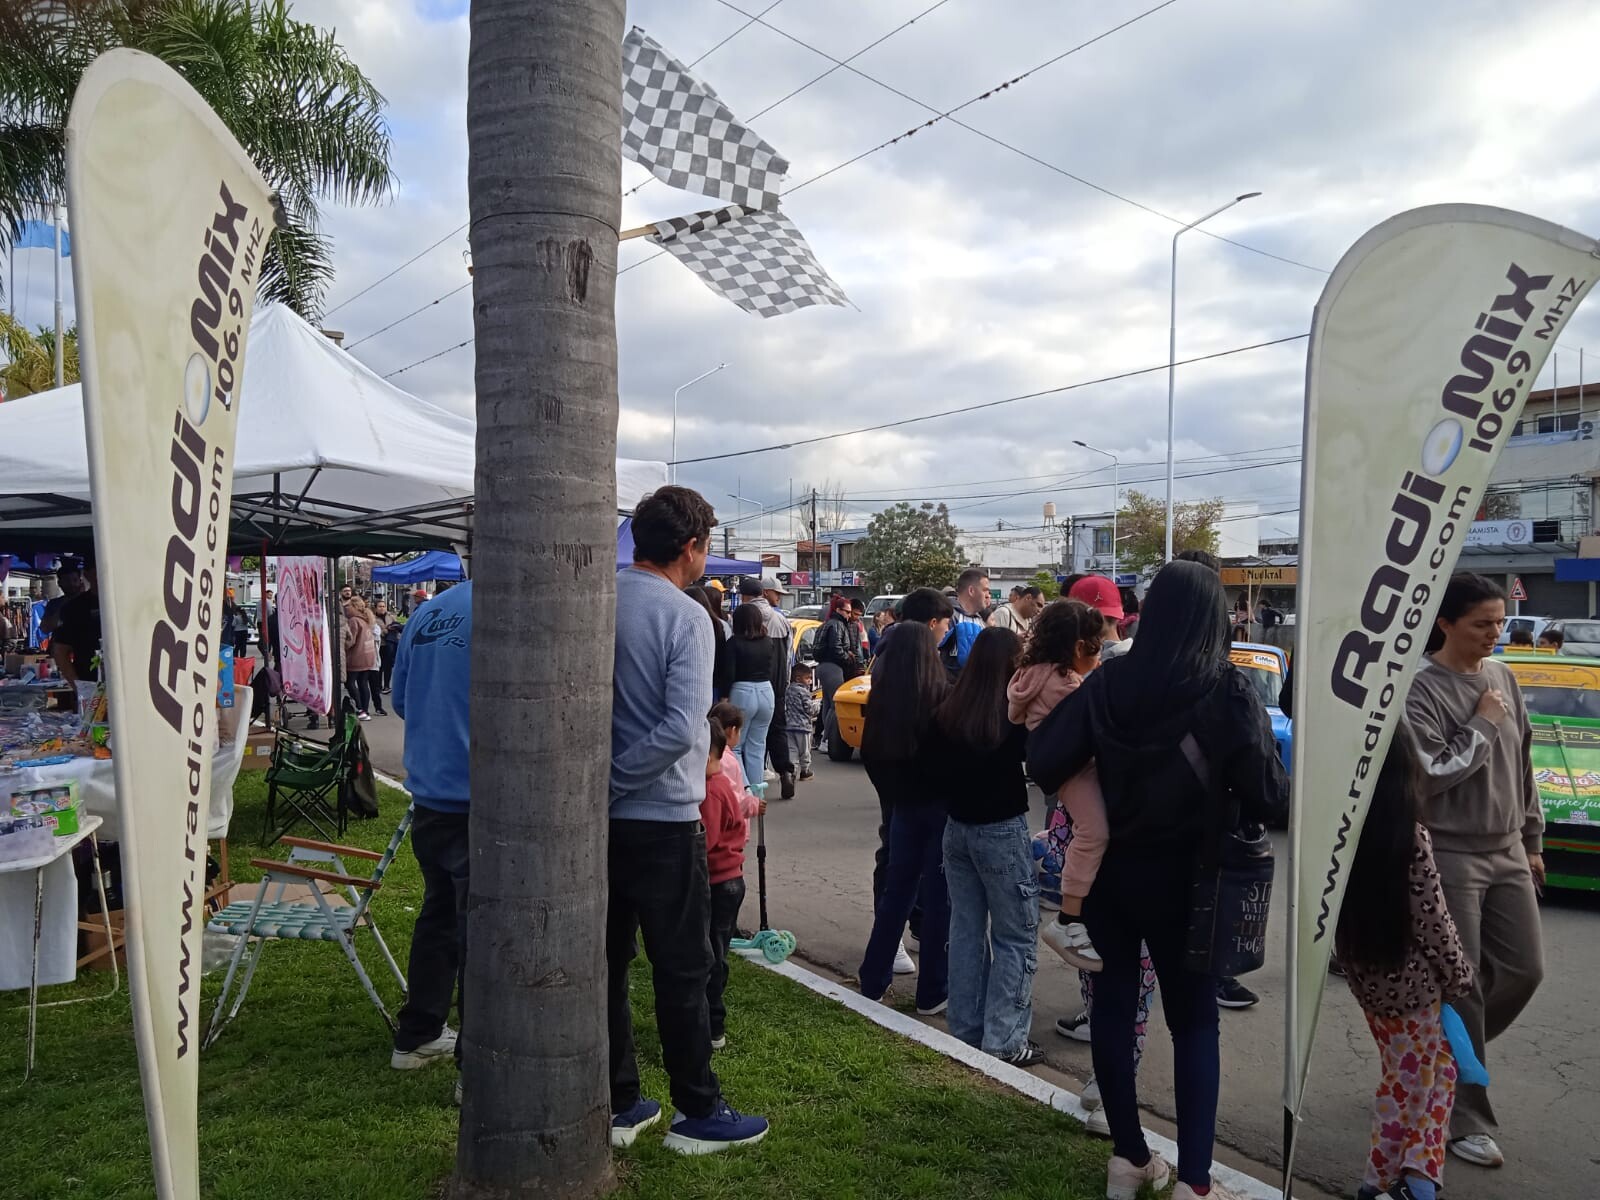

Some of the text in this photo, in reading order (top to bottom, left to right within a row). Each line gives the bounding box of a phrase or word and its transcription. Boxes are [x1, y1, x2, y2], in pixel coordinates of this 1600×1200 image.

[215, 216, 265, 411] 106.9 MHZ
[1468, 277, 1586, 453] 106.9 MHZ
[177, 446, 225, 1059] www.radio1069.com
[1313, 485, 1472, 943] www.radio1069.com
